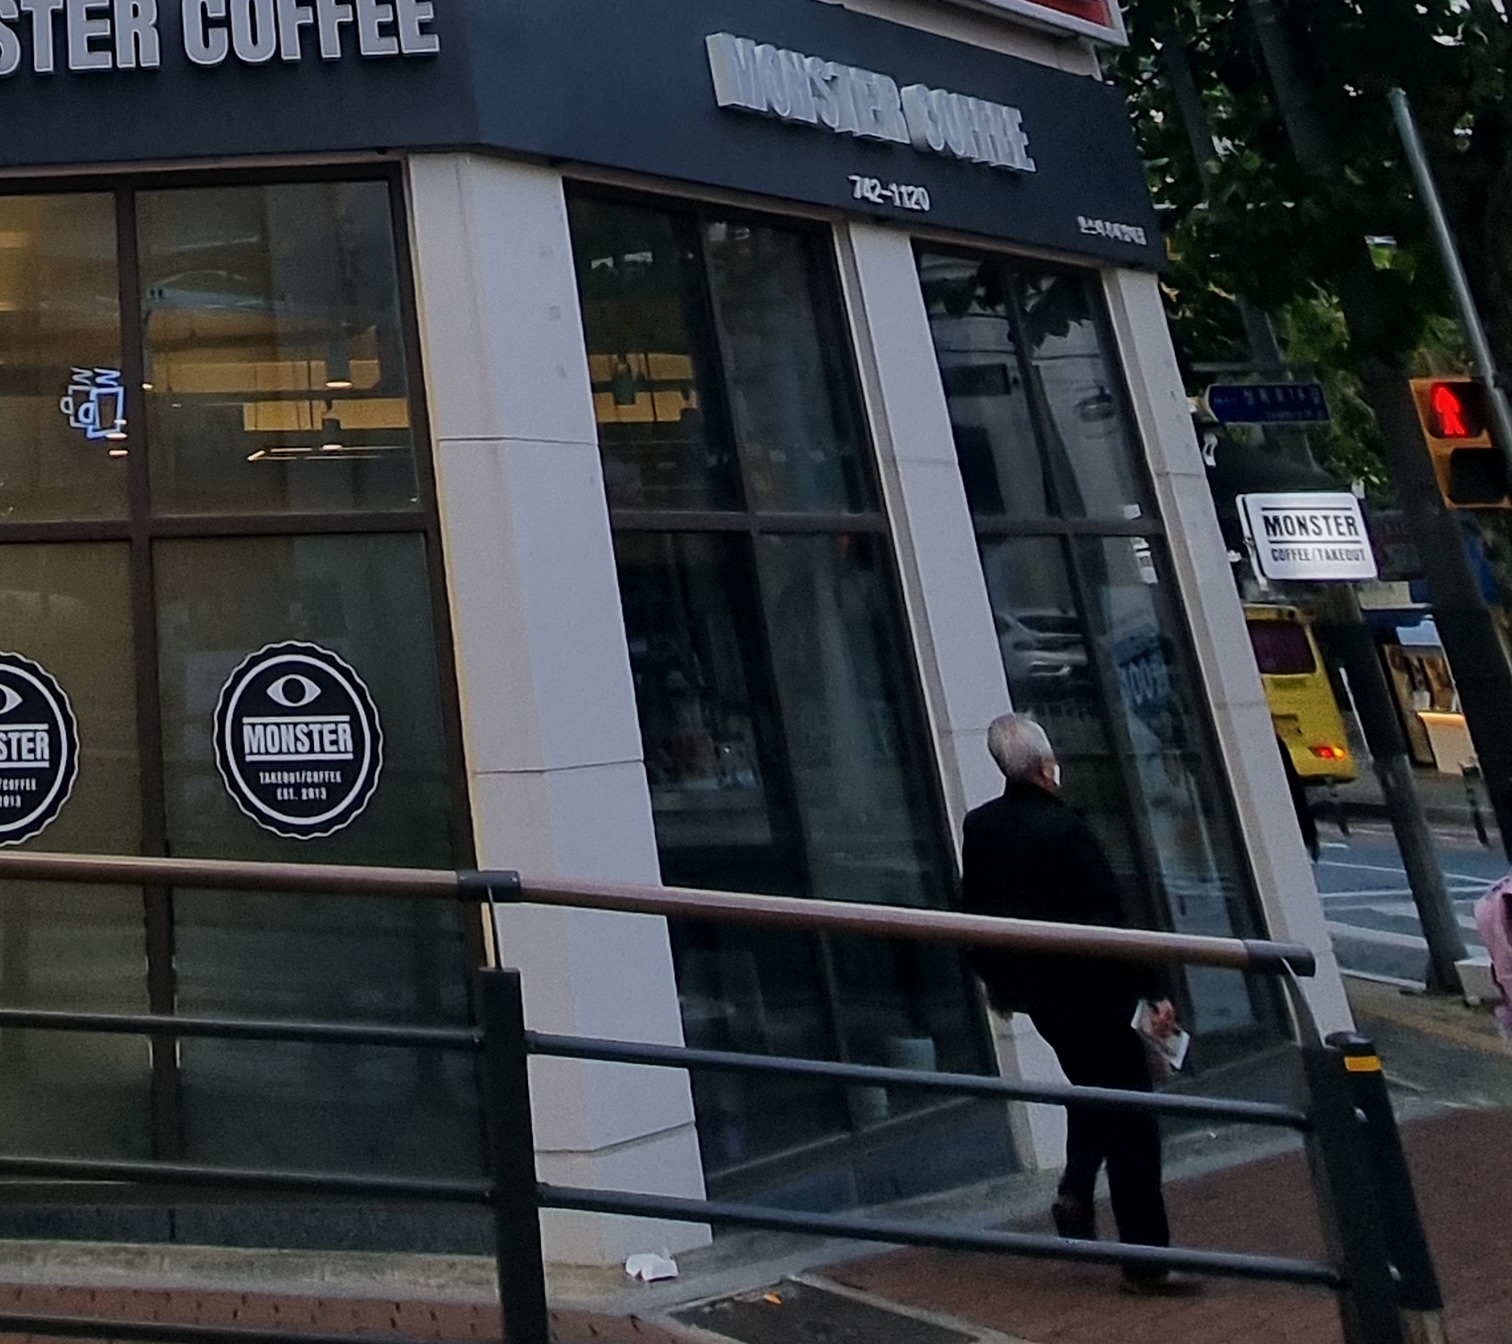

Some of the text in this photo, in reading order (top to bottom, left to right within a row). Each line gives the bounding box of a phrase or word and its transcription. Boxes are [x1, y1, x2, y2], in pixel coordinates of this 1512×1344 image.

[705, 32, 911, 144] MONSTER
[847, 174, 932, 212] 742-1120
[1262, 514, 1359, 538] MONSTER
[1270, 547, 1366, 563] COFFEE/TAKEOUT
[243, 722, 354, 754] MONSTER
[301, 786, 327, 801] 2013
